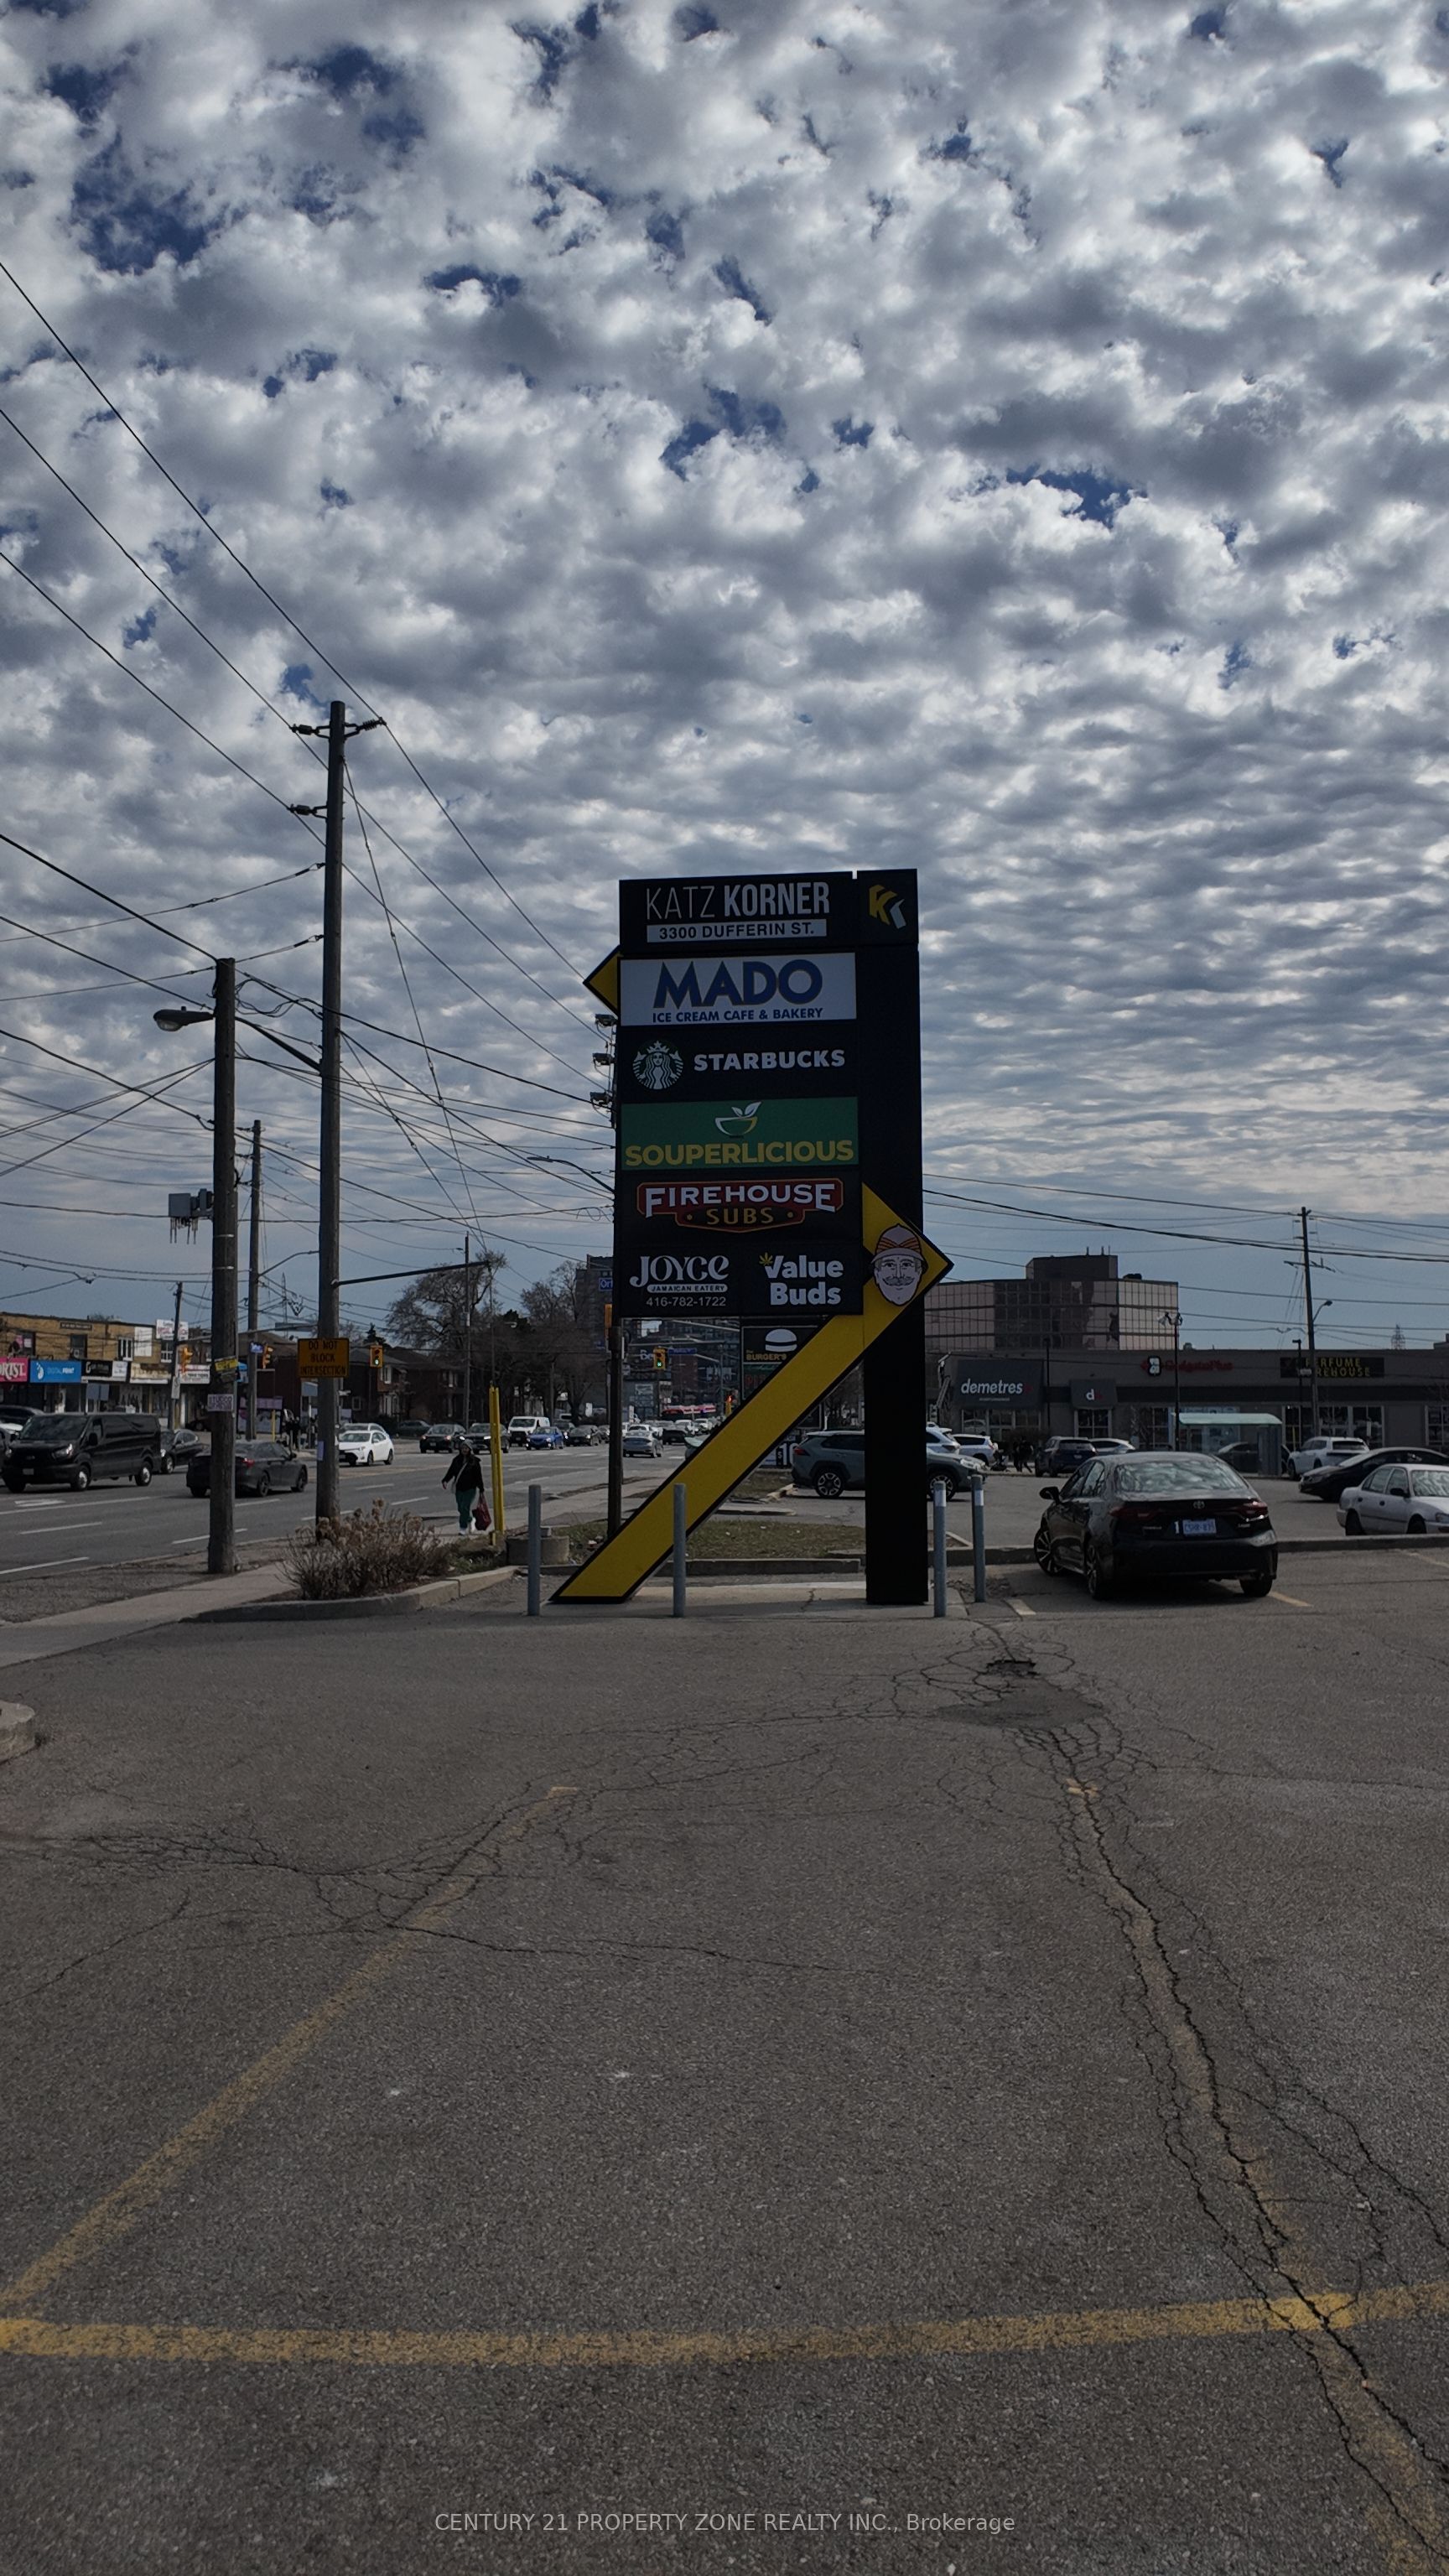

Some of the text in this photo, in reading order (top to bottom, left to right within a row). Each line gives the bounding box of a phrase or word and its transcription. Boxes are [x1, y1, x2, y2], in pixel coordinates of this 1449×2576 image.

[647, 881, 830, 920] KATZ KORNER
[659, 922, 814, 939] 3300 DUFFERIN ST.
[653, 959, 823, 1009] MADO
[652, 1007, 823, 1023] ICE CREAM CAFE & BAKERY
[693, 1049, 845, 1072] STARBUCKS
[625, 1140, 854, 1166] SOUPERLICIOUS
[645, 1182, 836, 1218] FIREHOUSE
[706, 1207, 775, 1226] SUBS
[764, 1254, 844, 1279] Value
[646, 1296, 727, 1307] 416-782-1722
[770, 1281, 842, 1306] Buds
[309, 1341, 337, 1349] DO NOT
[310, 1353, 335, 1363] BLOCK
[300, 1366, 346, 1375] INTERSECTION
[960, 1378, 1024, 1394] demetres
